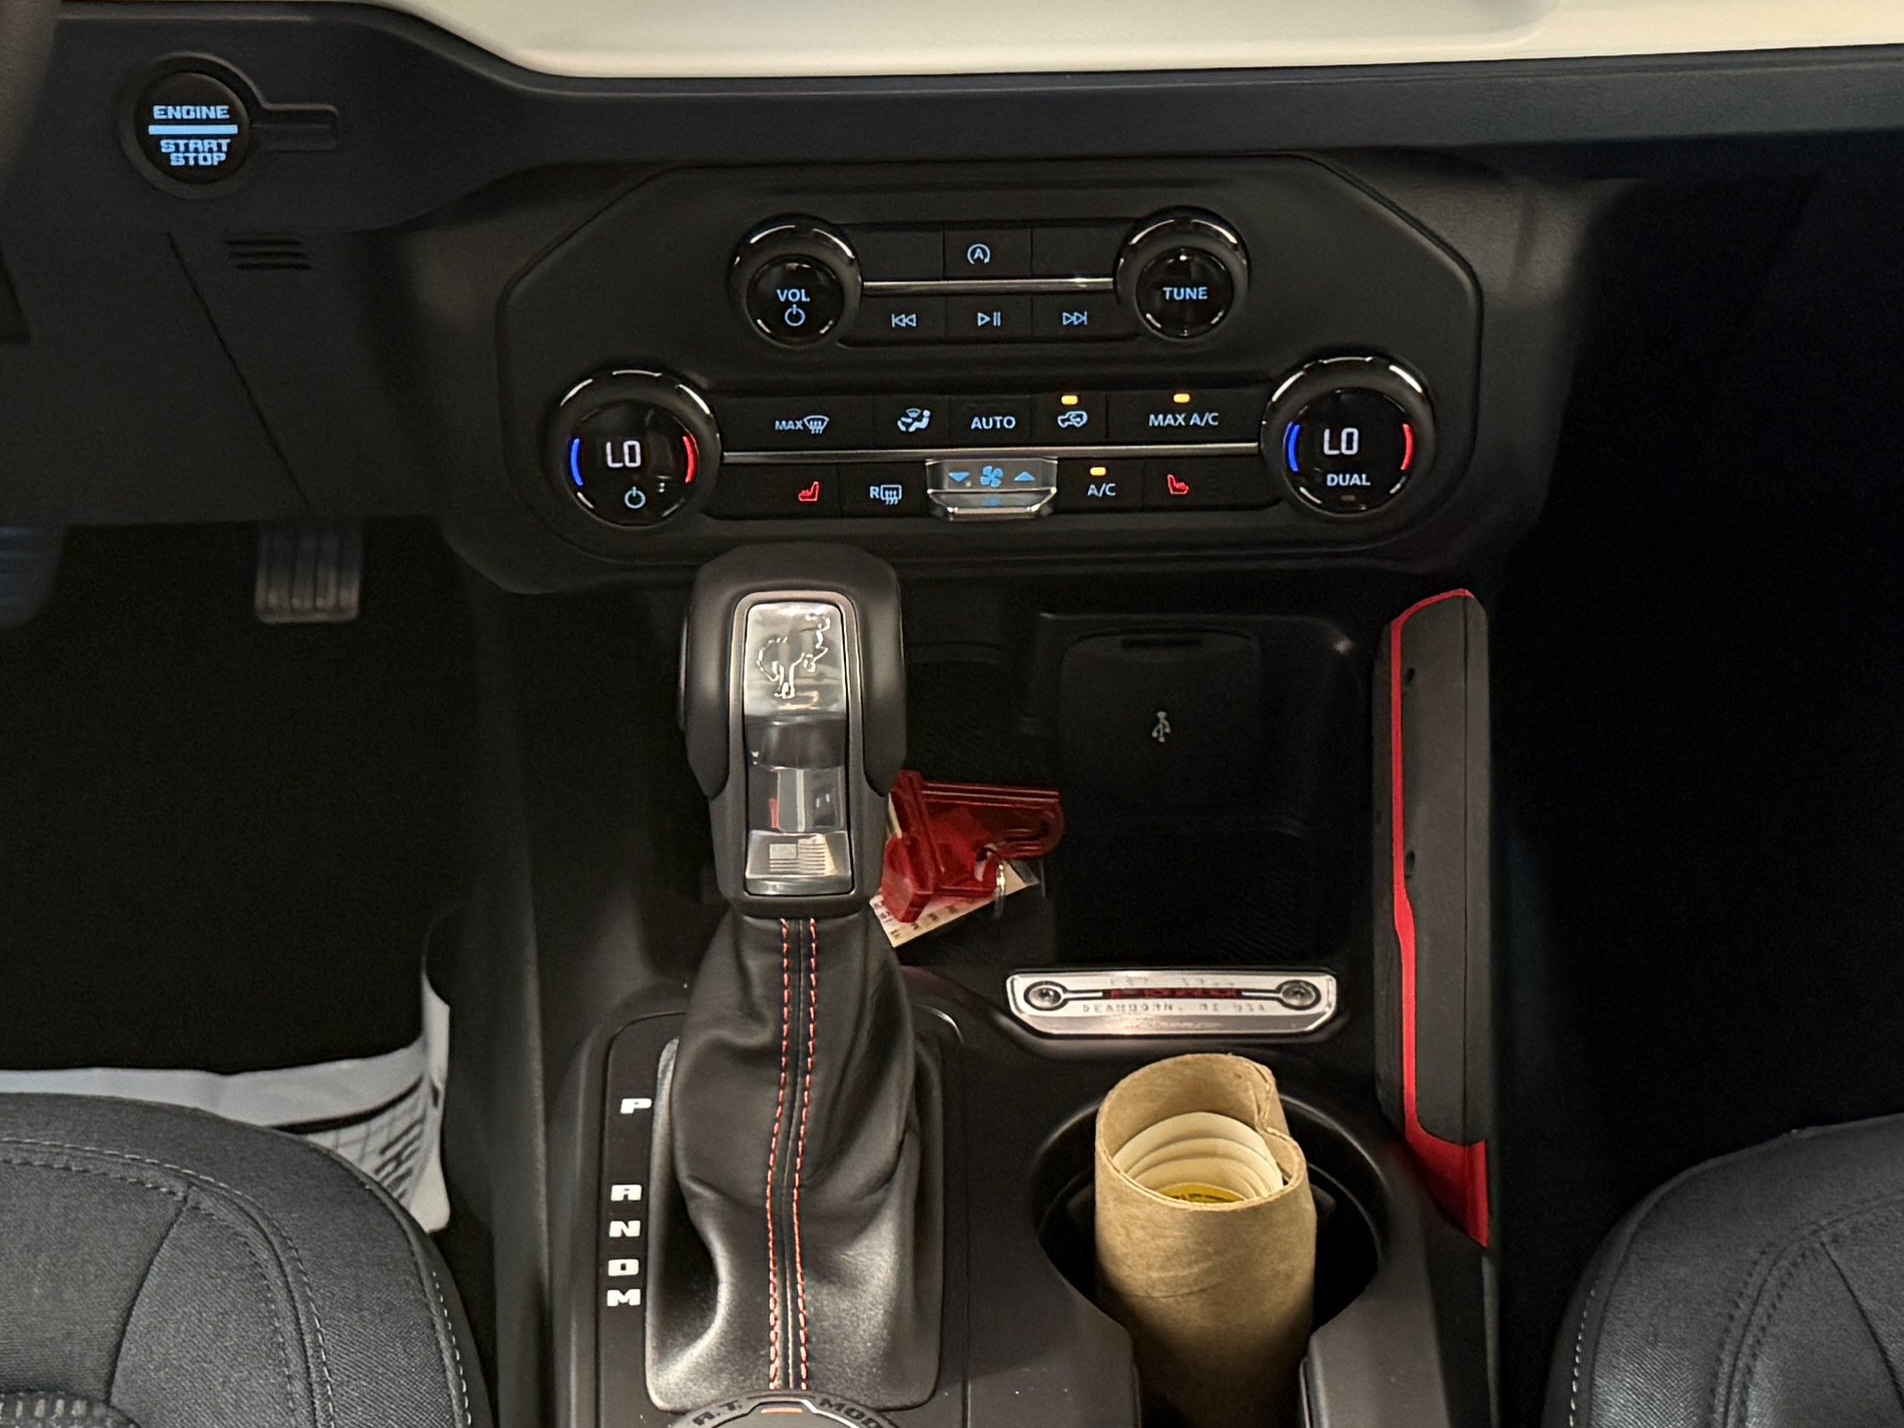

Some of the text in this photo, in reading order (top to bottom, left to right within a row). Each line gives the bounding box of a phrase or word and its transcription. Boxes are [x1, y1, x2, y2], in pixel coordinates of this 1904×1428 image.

[153, 105, 231, 120] ENGINE
[160, 139, 231, 153] START
[170, 152, 227, 166] STOP
[776, 289, 810, 302] VOL
[1162, 286, 1208, 301] TUNE
[775, 420, 804, 430] MAX
[970, 414, 1016, 430] AUTO
[1148, 412, 1219, 428] MAX A/C
[1322, 427, 1359, 456] LO
[606, 440, 641, 469] LO
[1326, 473, 1371, 487] DUAL
[1087, 482, 1116, 497] A/C
[620, 1097, 652, 1114] P
[609, 1220, 641, 1238] N
[606, 1288, 641, 1307] M
